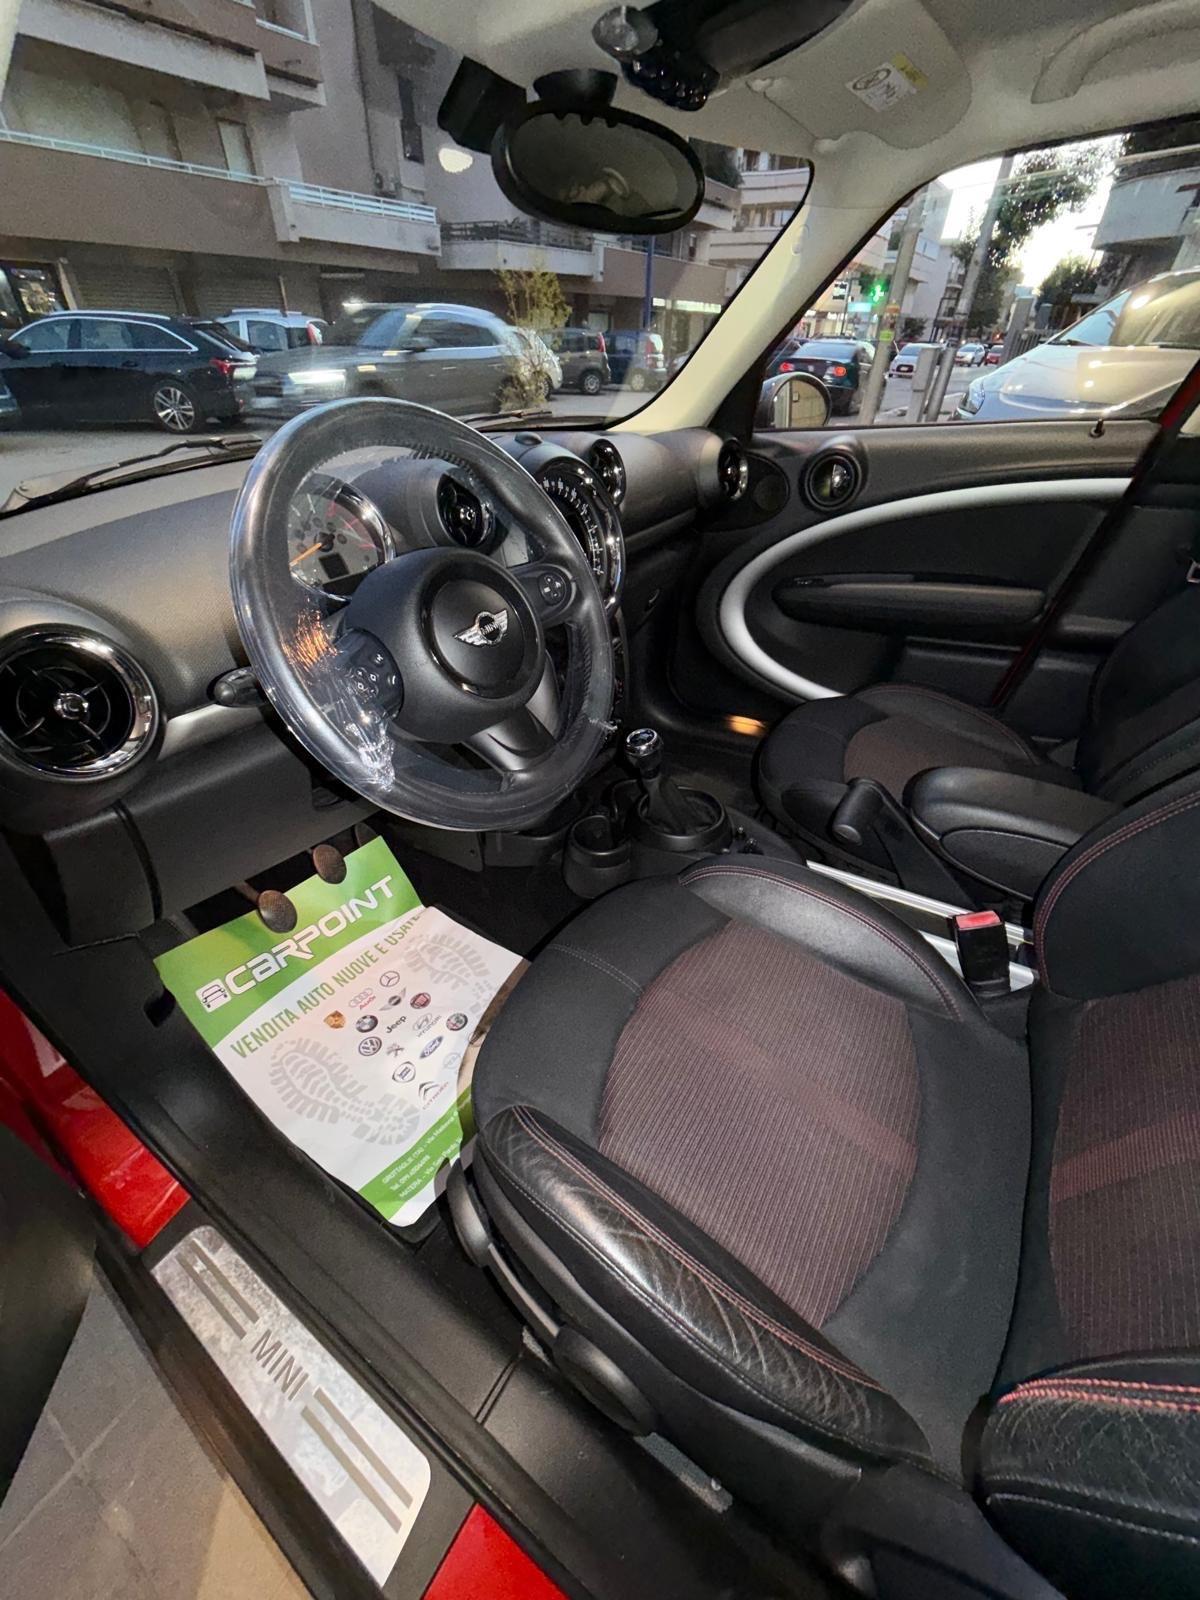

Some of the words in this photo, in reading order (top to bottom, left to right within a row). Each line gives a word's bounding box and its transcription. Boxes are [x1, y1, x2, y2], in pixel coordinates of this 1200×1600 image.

[230, 1010, 300, 1059] VENDITA
[296, 981, 335, 1015] AUTO
[331, 949, 380, 988] NUOVE
[374, 942, 389, 955] E
[385, 1015, 407, 1034] Jeep
[250, 1328, 310, 1402] MINI
